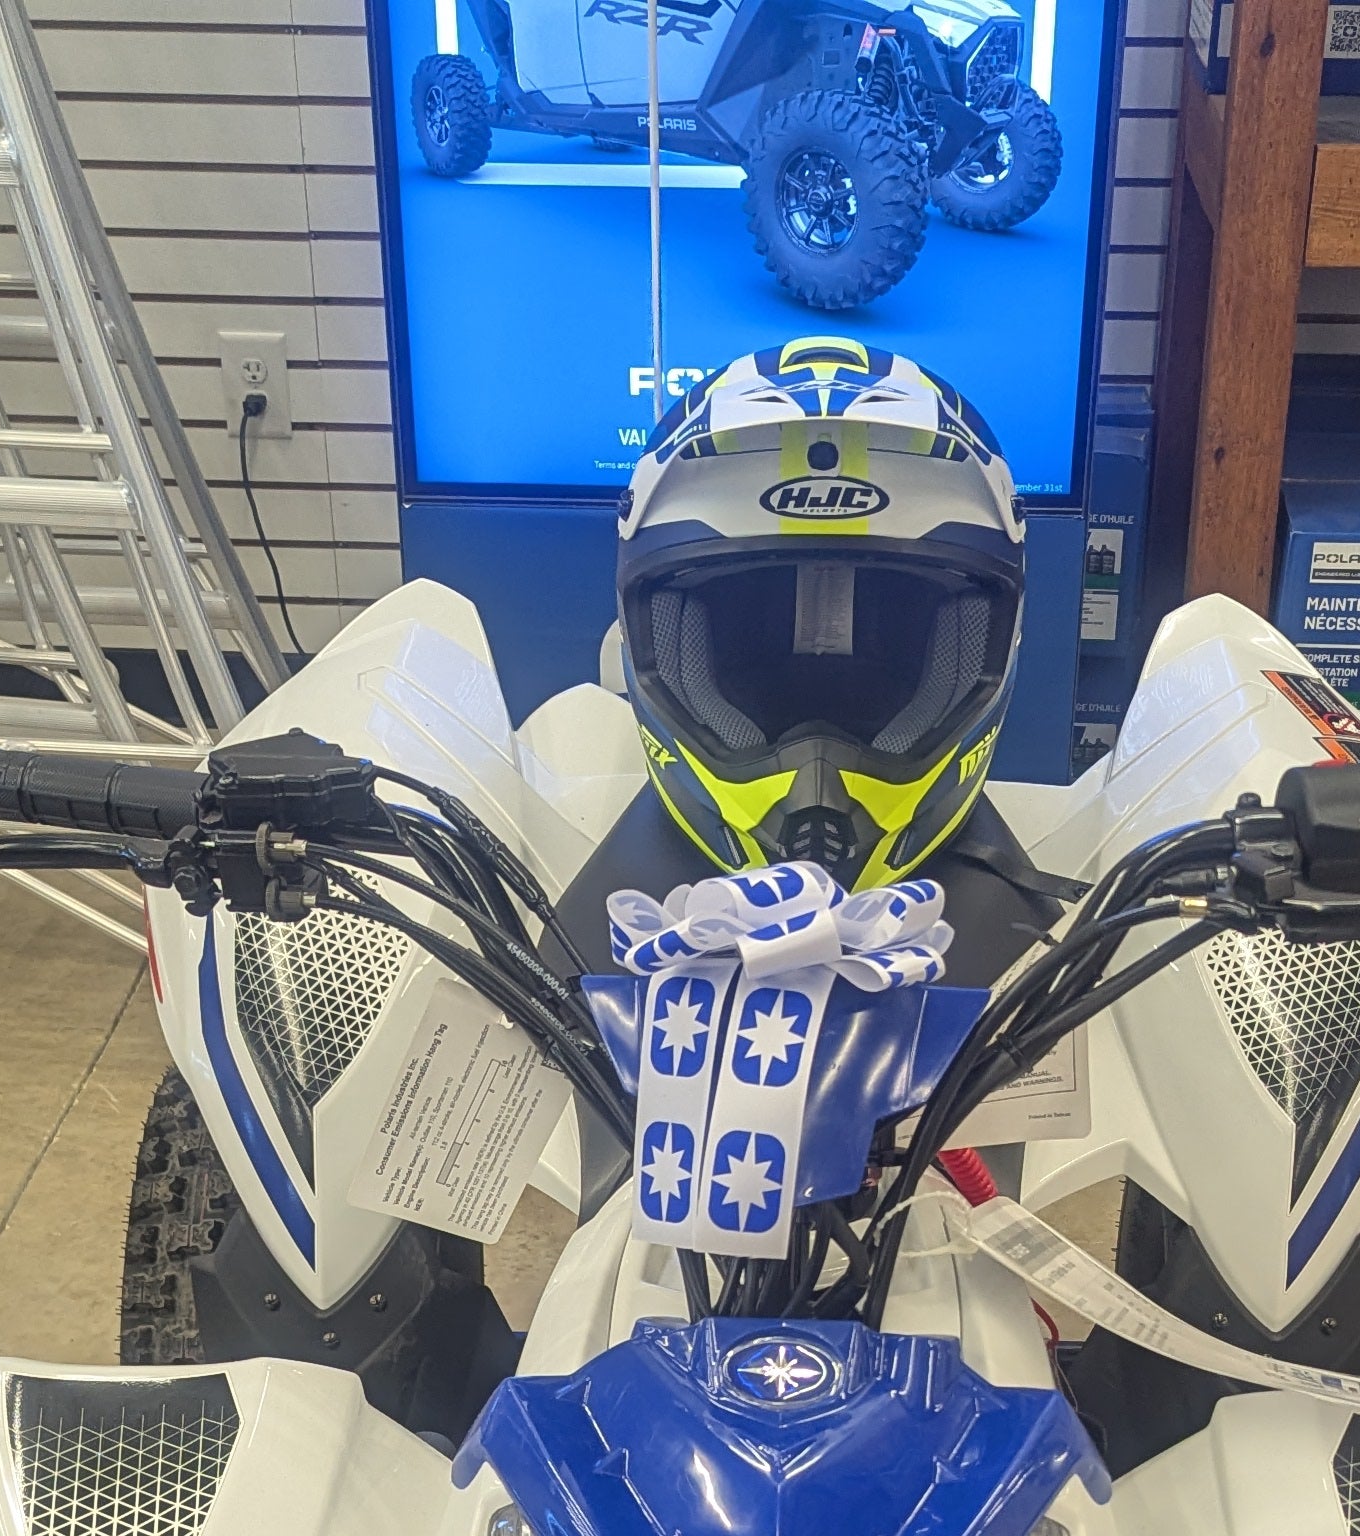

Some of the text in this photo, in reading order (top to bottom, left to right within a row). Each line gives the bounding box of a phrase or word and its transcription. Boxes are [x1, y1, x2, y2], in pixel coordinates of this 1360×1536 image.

[617, 461, 630, 469] and
[777, 486, 875, 509] HJC
[374, 1022, 448, 1176] Consumer Emissions Information Hang Tag
[379, 1055, 419, 1134] Polaris Industries Inc.
[401, 1167, 413, 1185] Model
[403, 1188, 416, 1208] Engine
[412, 1156, 431, 1188] Description:
